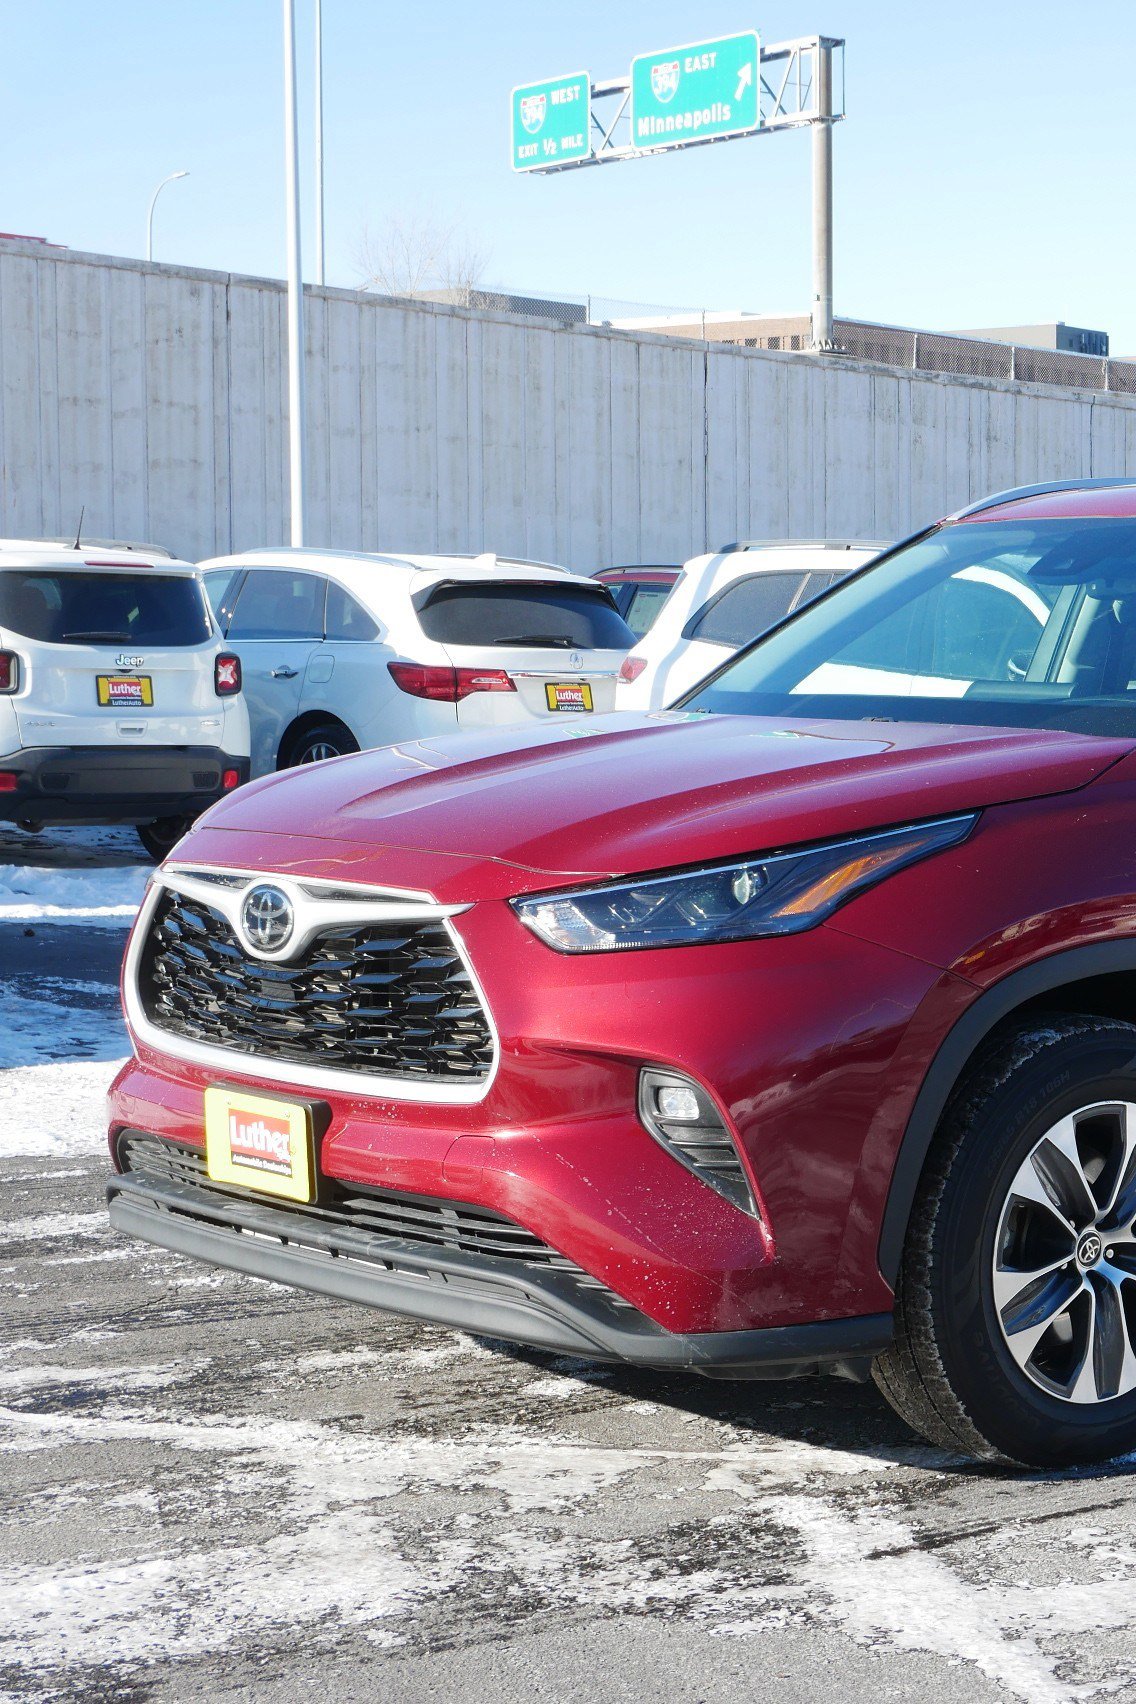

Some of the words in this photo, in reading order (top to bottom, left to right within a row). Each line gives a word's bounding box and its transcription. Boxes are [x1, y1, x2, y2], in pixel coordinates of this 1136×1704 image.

[685, 52, 717, 73] EAST
[551, 85, 580, 105] WEST
[638, 102, 731, 137] Minneapolis
[518, 142, 538, 159] EXIT
[561, 133, 583, 150] MILE
[115, 653, 144, 668] Jeep
[109, 683, 141, 695] Luther
[556, 690, 583, 701] Luther
[230, 1115, 290, 1153] Luther
